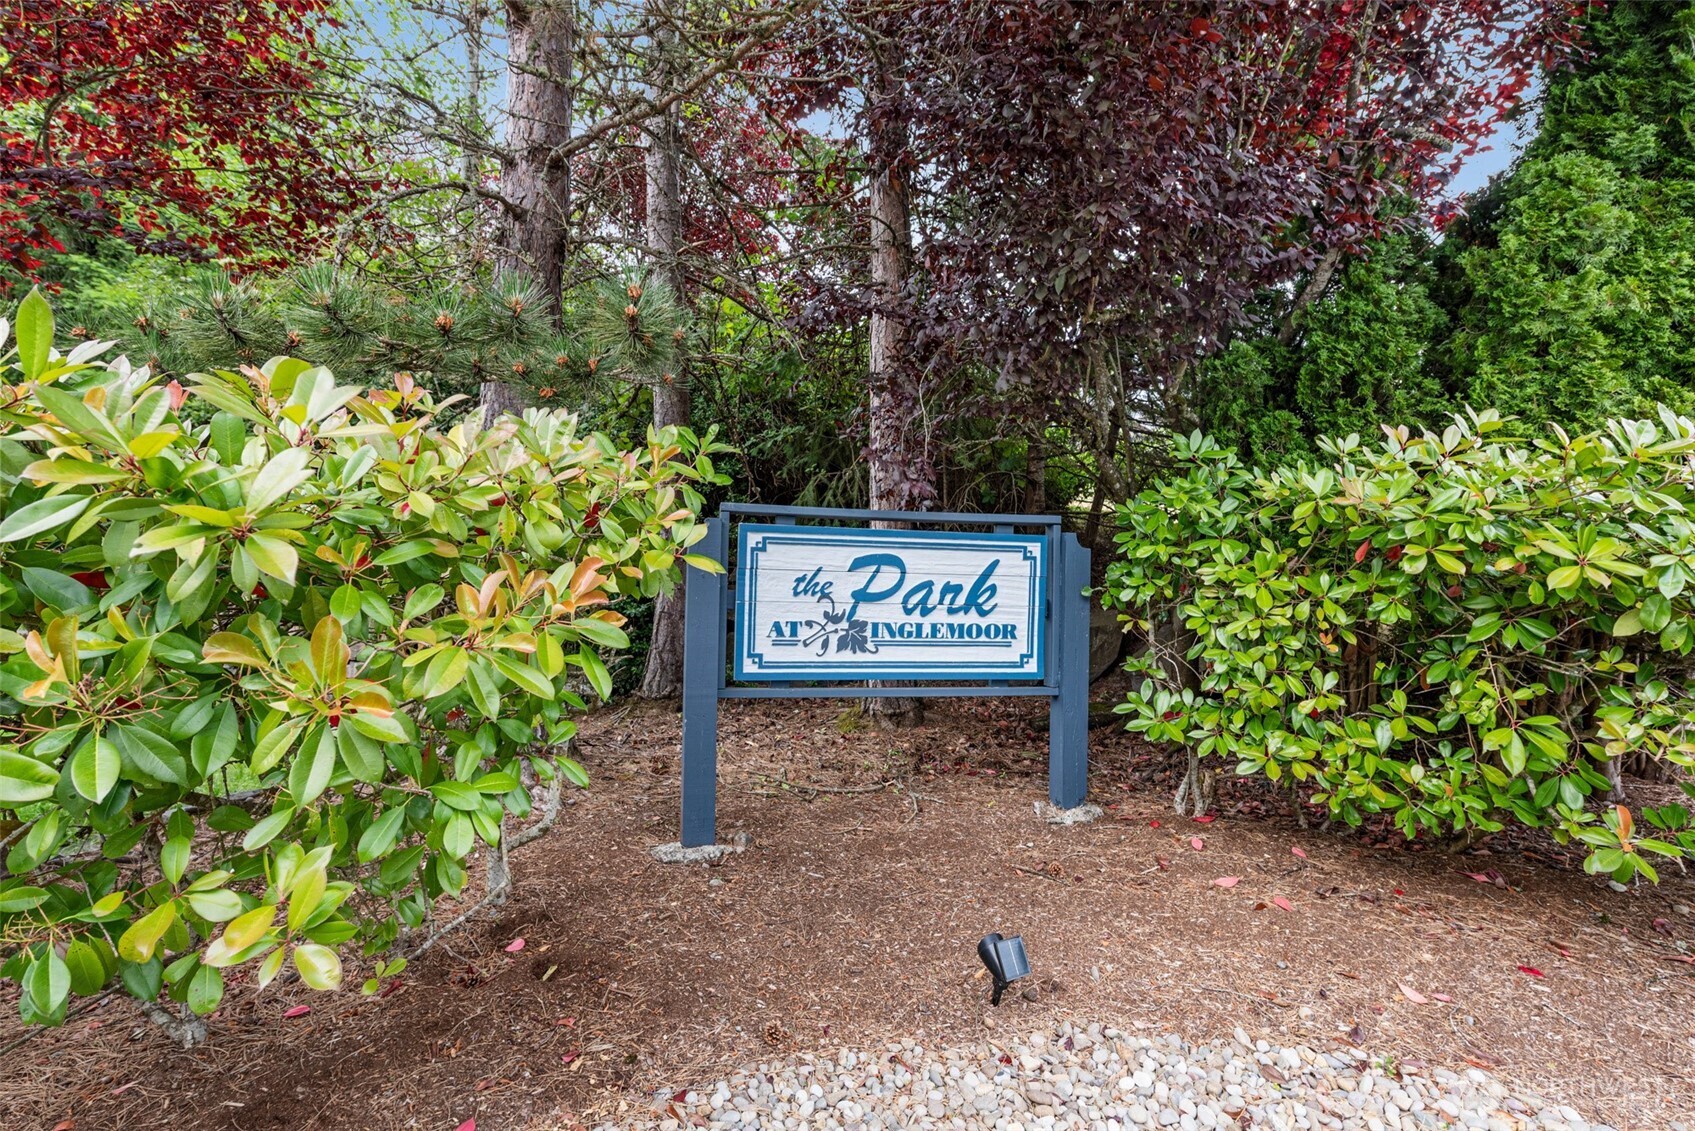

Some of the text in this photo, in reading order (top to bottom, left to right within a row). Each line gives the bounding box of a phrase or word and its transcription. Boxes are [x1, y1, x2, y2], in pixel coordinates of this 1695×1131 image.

[791, 553, 1001, 622] the Park
[766, 620, 1017, 640] AT INGLEMOOR
